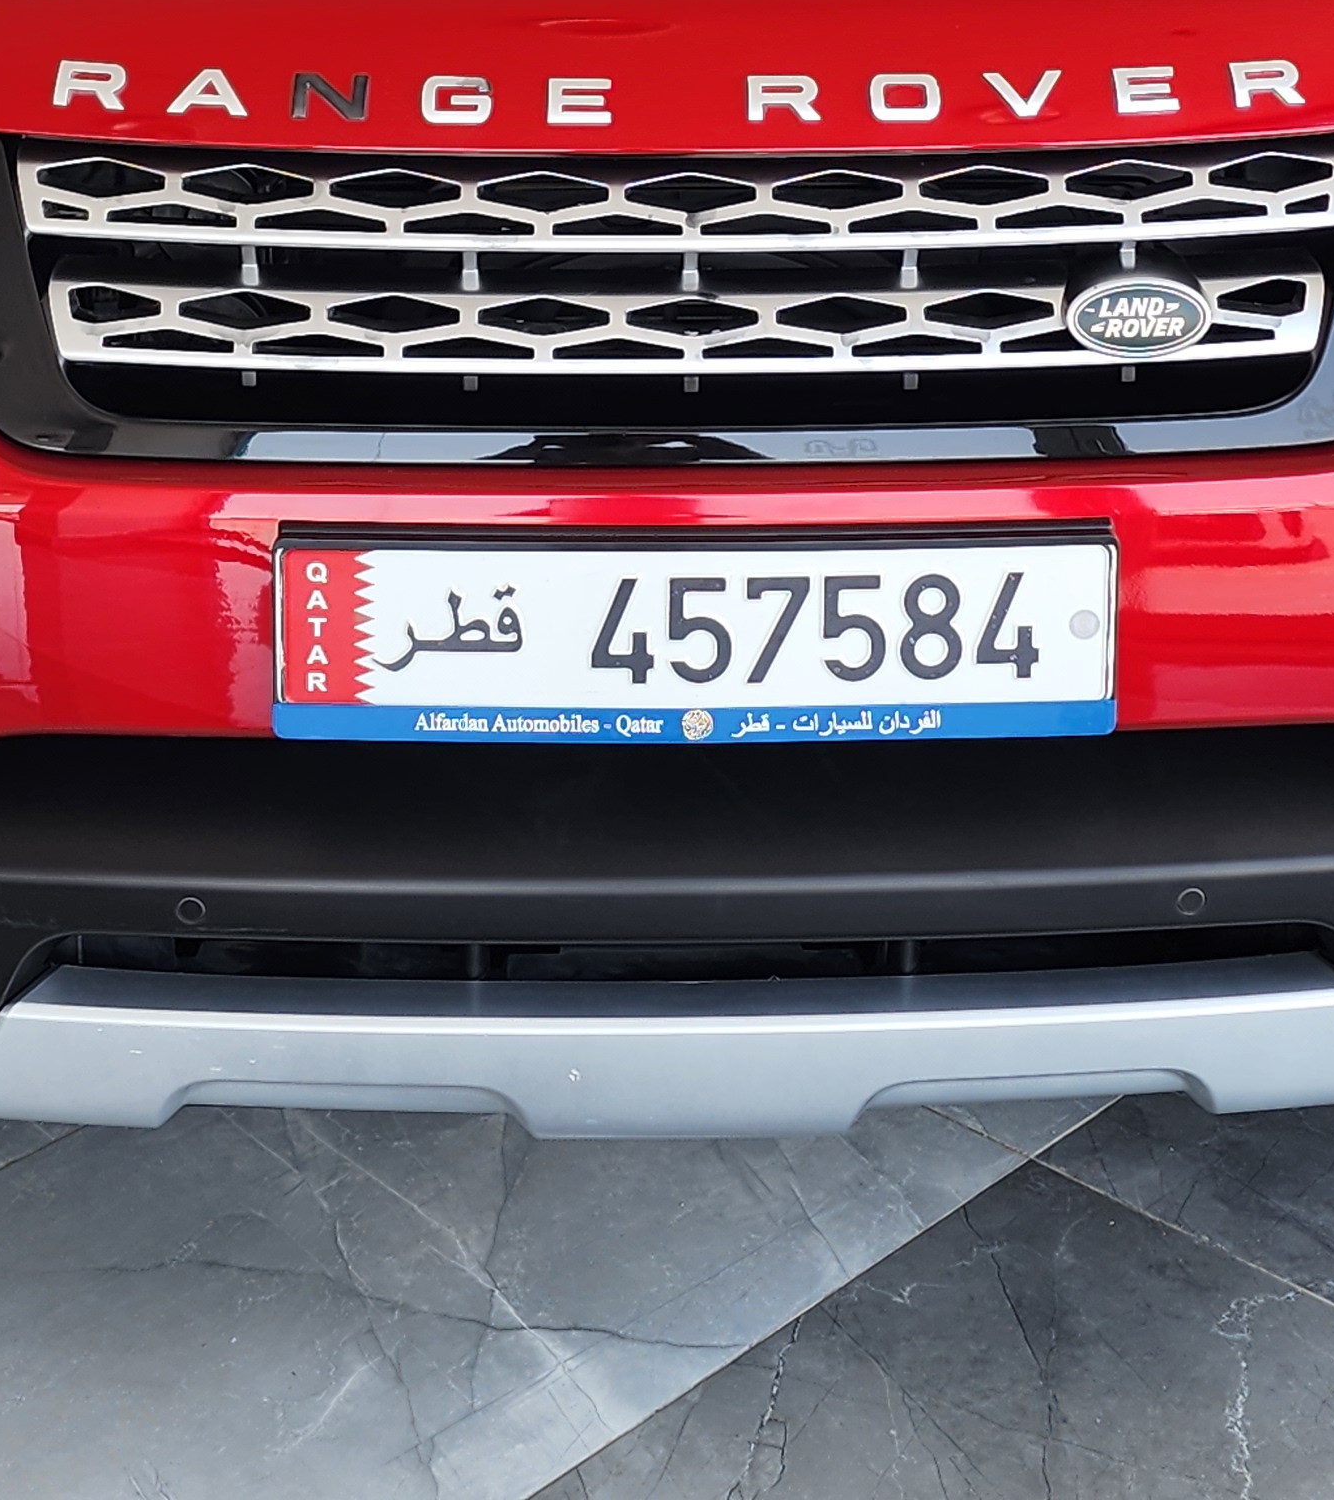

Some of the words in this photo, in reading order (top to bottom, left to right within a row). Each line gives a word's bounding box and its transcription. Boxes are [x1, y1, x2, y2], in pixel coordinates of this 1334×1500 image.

[52, 58, 613, 125] RANGE
[746, 58, 1307, 122] ROVER
[1098, 297, 1165, 318] LAND
[1104, 317, 1186, 338] ROVER
[305, 561, 329, 692] QATAR
[371, 585, 523, 672] قطر
[591, 572, 1040, 685] 457584
[414, 712, 488, 732] Alfardan
[491, 713, 600, 733] Automobiles
[615, 714, 664, 738] Qatar
[731, 712, 770, 739] قطر
[792, 709, 873, 737] للسيارات
[878, 709, 942, 735] الفردان
